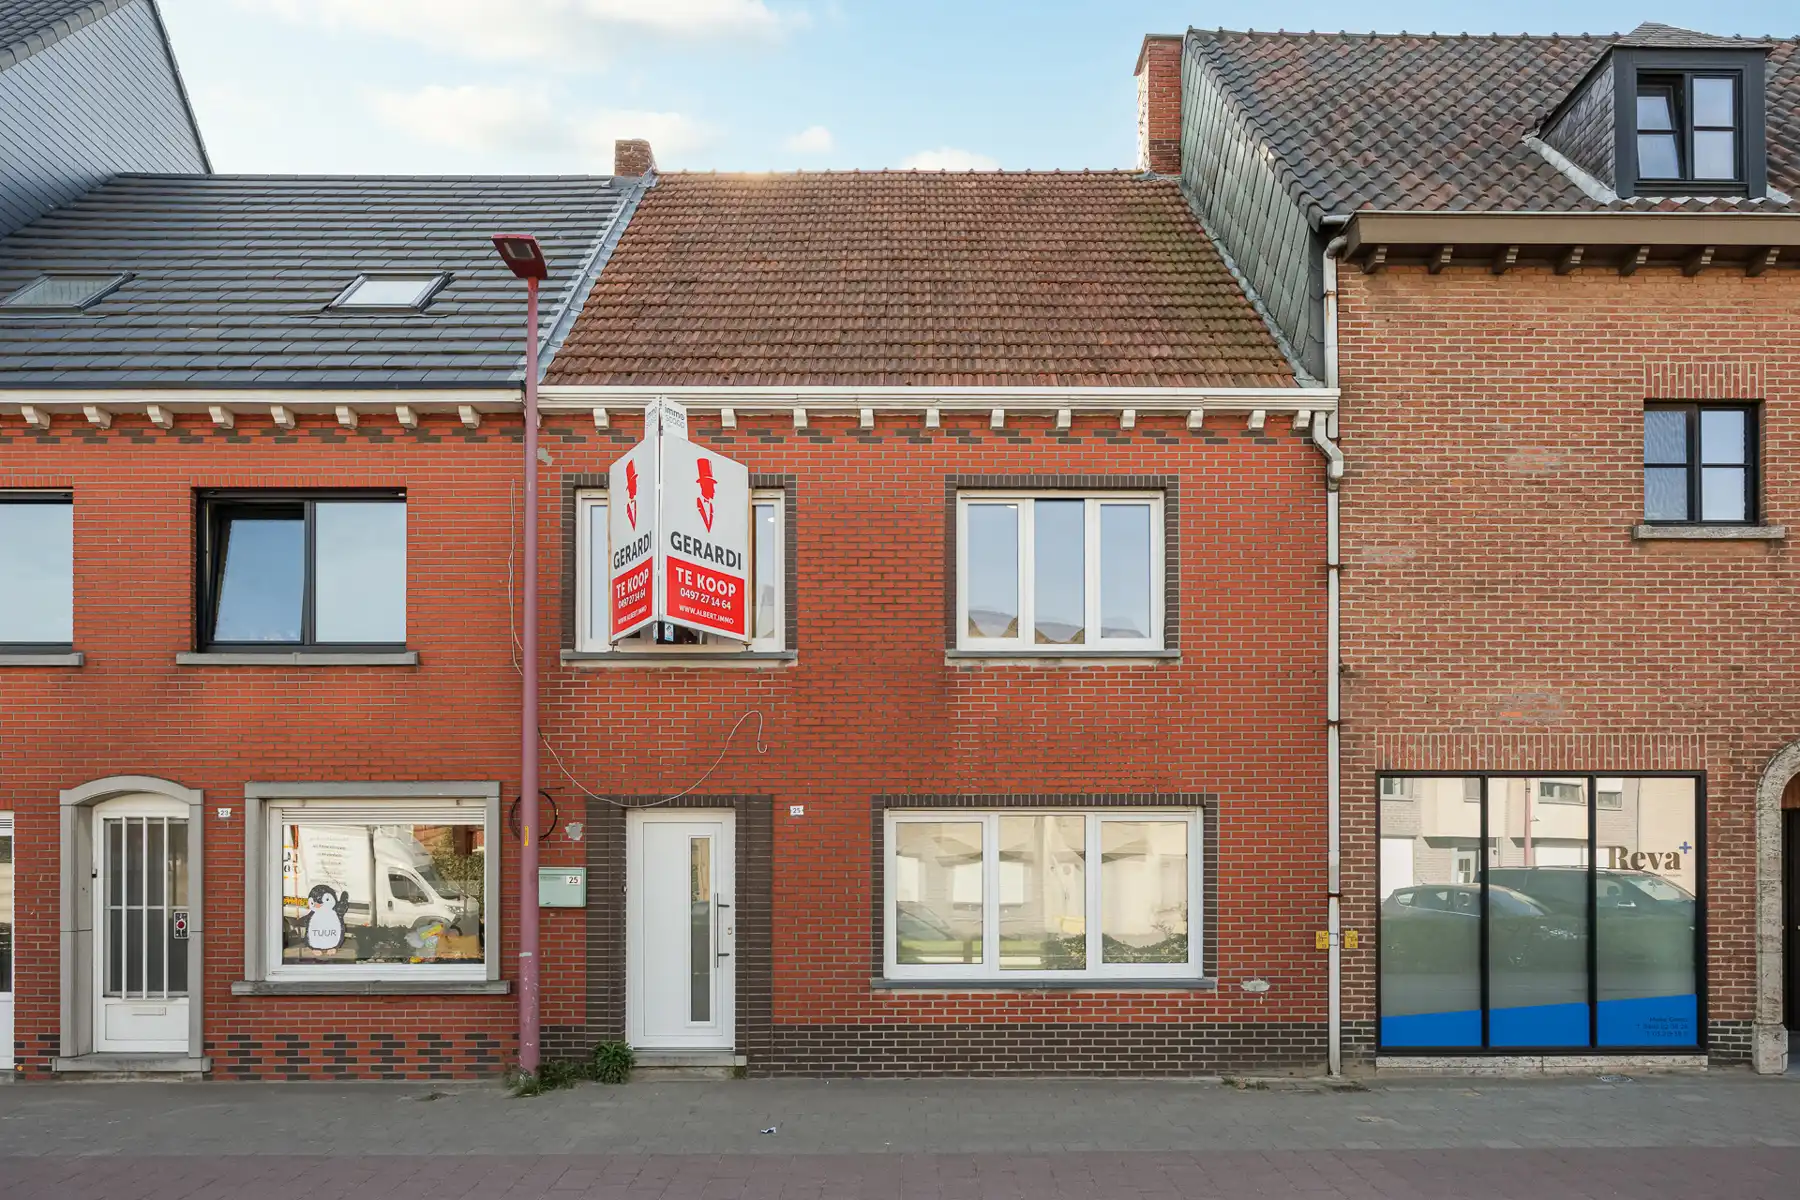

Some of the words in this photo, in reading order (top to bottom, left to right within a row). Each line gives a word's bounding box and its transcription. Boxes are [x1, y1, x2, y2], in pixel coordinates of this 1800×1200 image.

[613, 530, 652, 570] GERARDI
[670, 531, 741, 570] GERARDI
[616, 580, 626, 598] TE
[627, 568, 649, 593] KOOP
[675, 566, 692, 586] TE
[697, 573, 736, 597] KOOP
[680, 587, 699, 600] 0497
[700, 593, 710, 604] 27
[711, 597, 720, 607] 14
[721, 599, 731, 610] 64
[678, 604, 734, 625] WWW.ALBERT.IMMO
[568, 876, 579, 884] 25
[312, 929, 337, 937] TUUR
